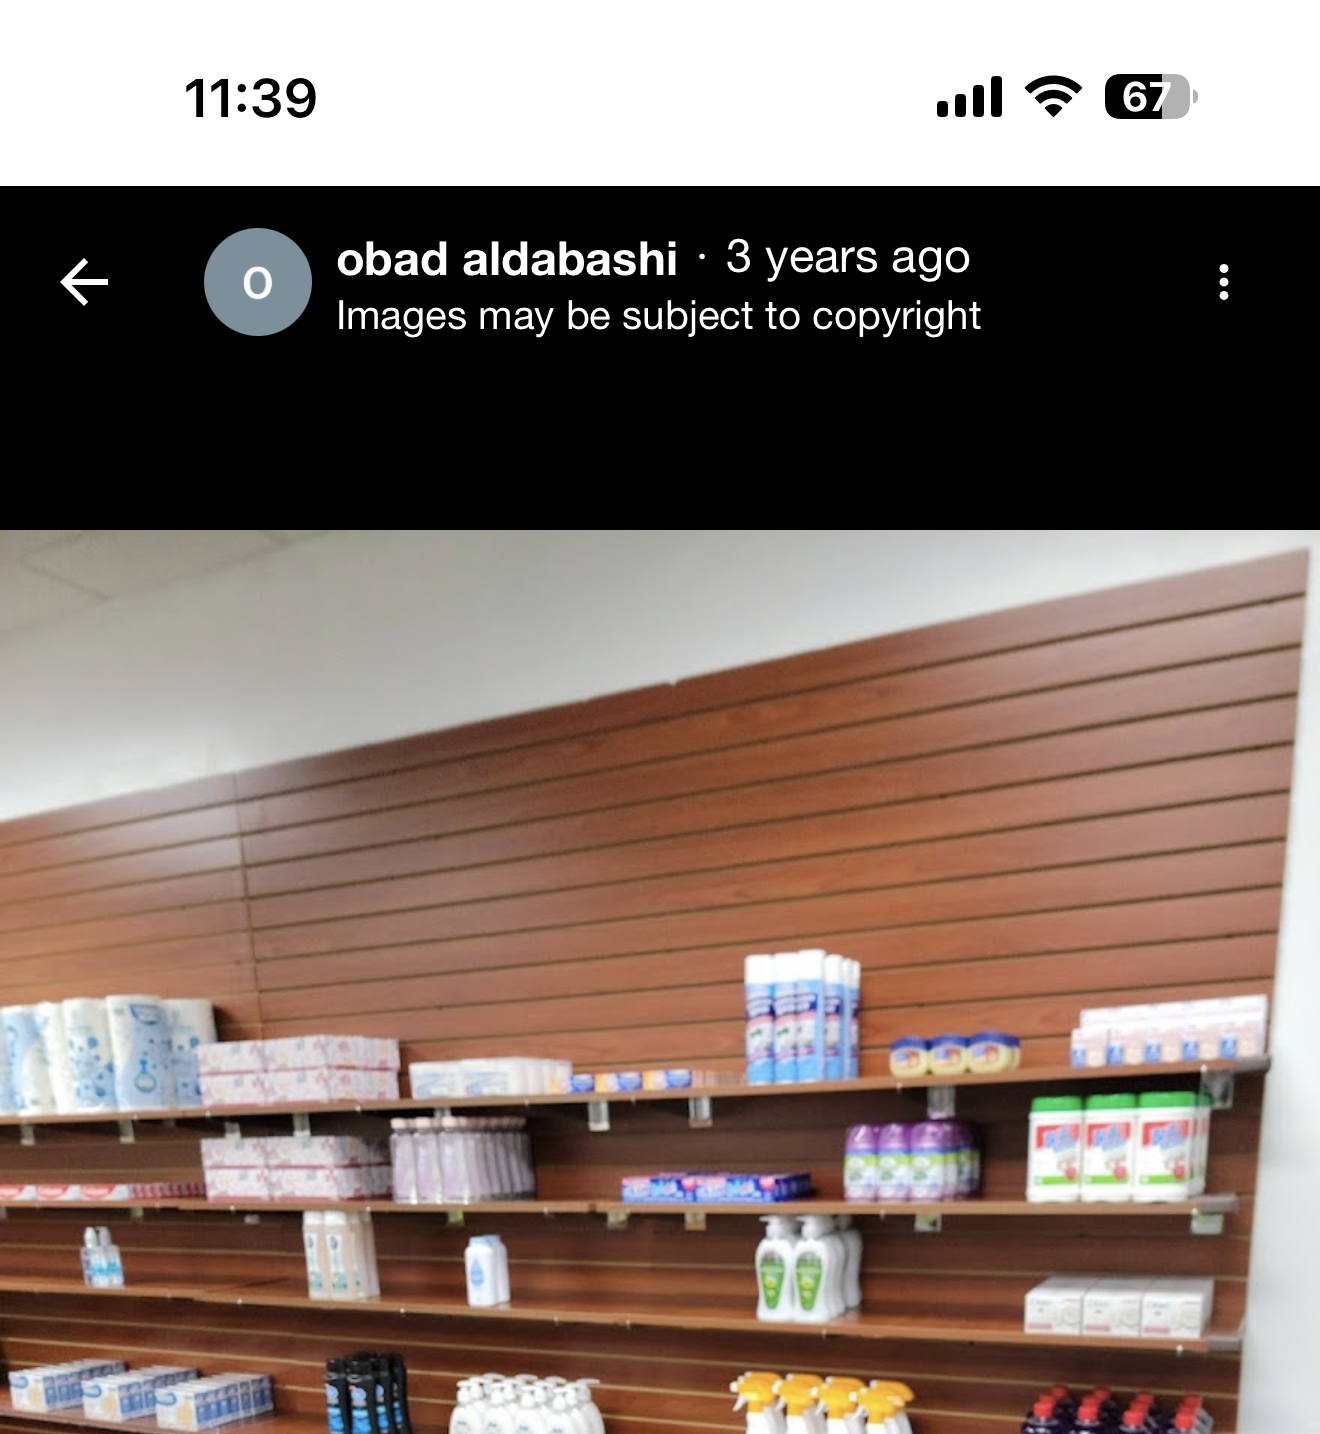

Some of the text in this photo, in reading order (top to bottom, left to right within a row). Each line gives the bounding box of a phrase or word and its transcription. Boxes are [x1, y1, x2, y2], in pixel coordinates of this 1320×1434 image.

[185, 77, 317, 119] 11:39
[1122, 81, 1172, 113] 67
[337, 240, 677, 277] obad aldabashi
[726, 237, 971, 283] 3 years ago
[338, 299, 982, 339] Images may be subject to copyright
